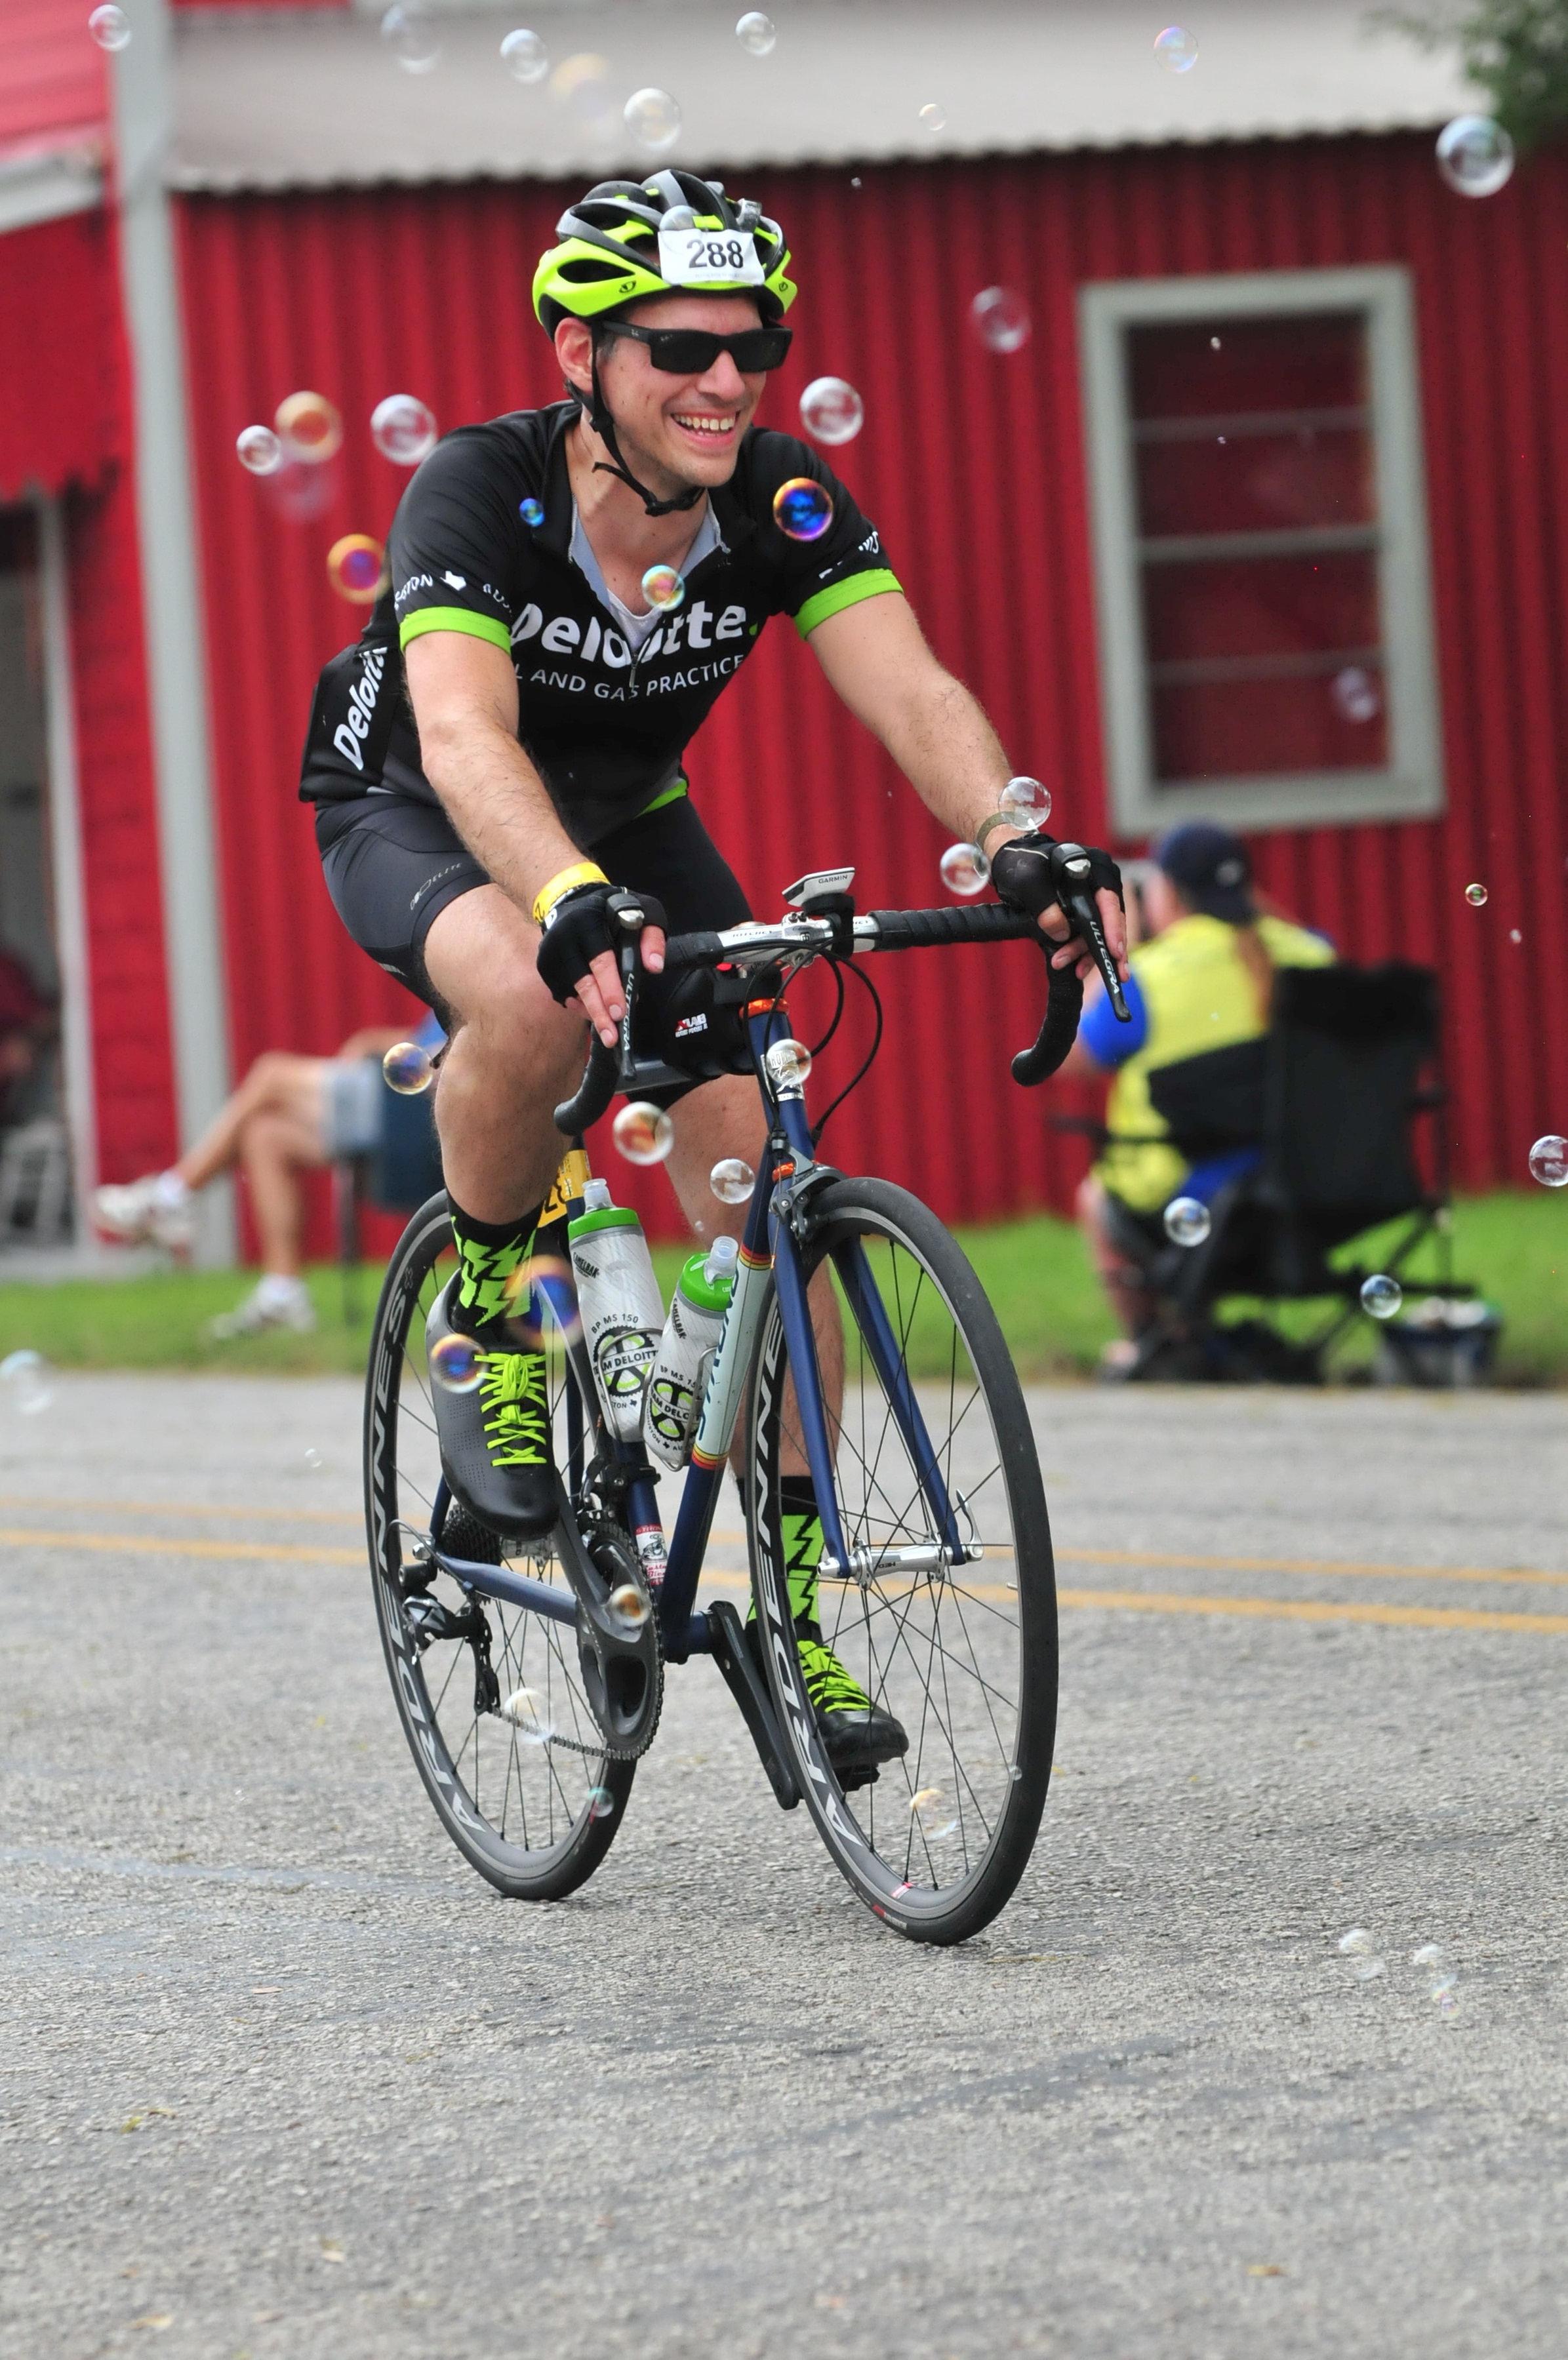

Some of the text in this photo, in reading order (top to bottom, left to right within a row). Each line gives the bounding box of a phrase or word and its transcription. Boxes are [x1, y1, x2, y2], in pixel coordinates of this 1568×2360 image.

[687, 239, 744, 269] 288
[530, 669, 586, 692] AND
[646, 654, 744, 696] PRACTICE
[818, 874, 848, 884] GARMIN
[1089, 921, 1120, 994] ULTEGRA
[624, 972, 635, 1051] ULTEGRA
[591, 1313, 639, 1334] BP MS 150
[614, 1350, 658, 1367] DELOITT
[660, 1365, 668, 1374] BP
[670, 1370, 684, 1381] MS
[755, 1306, 863, 1847] ARDENNE
